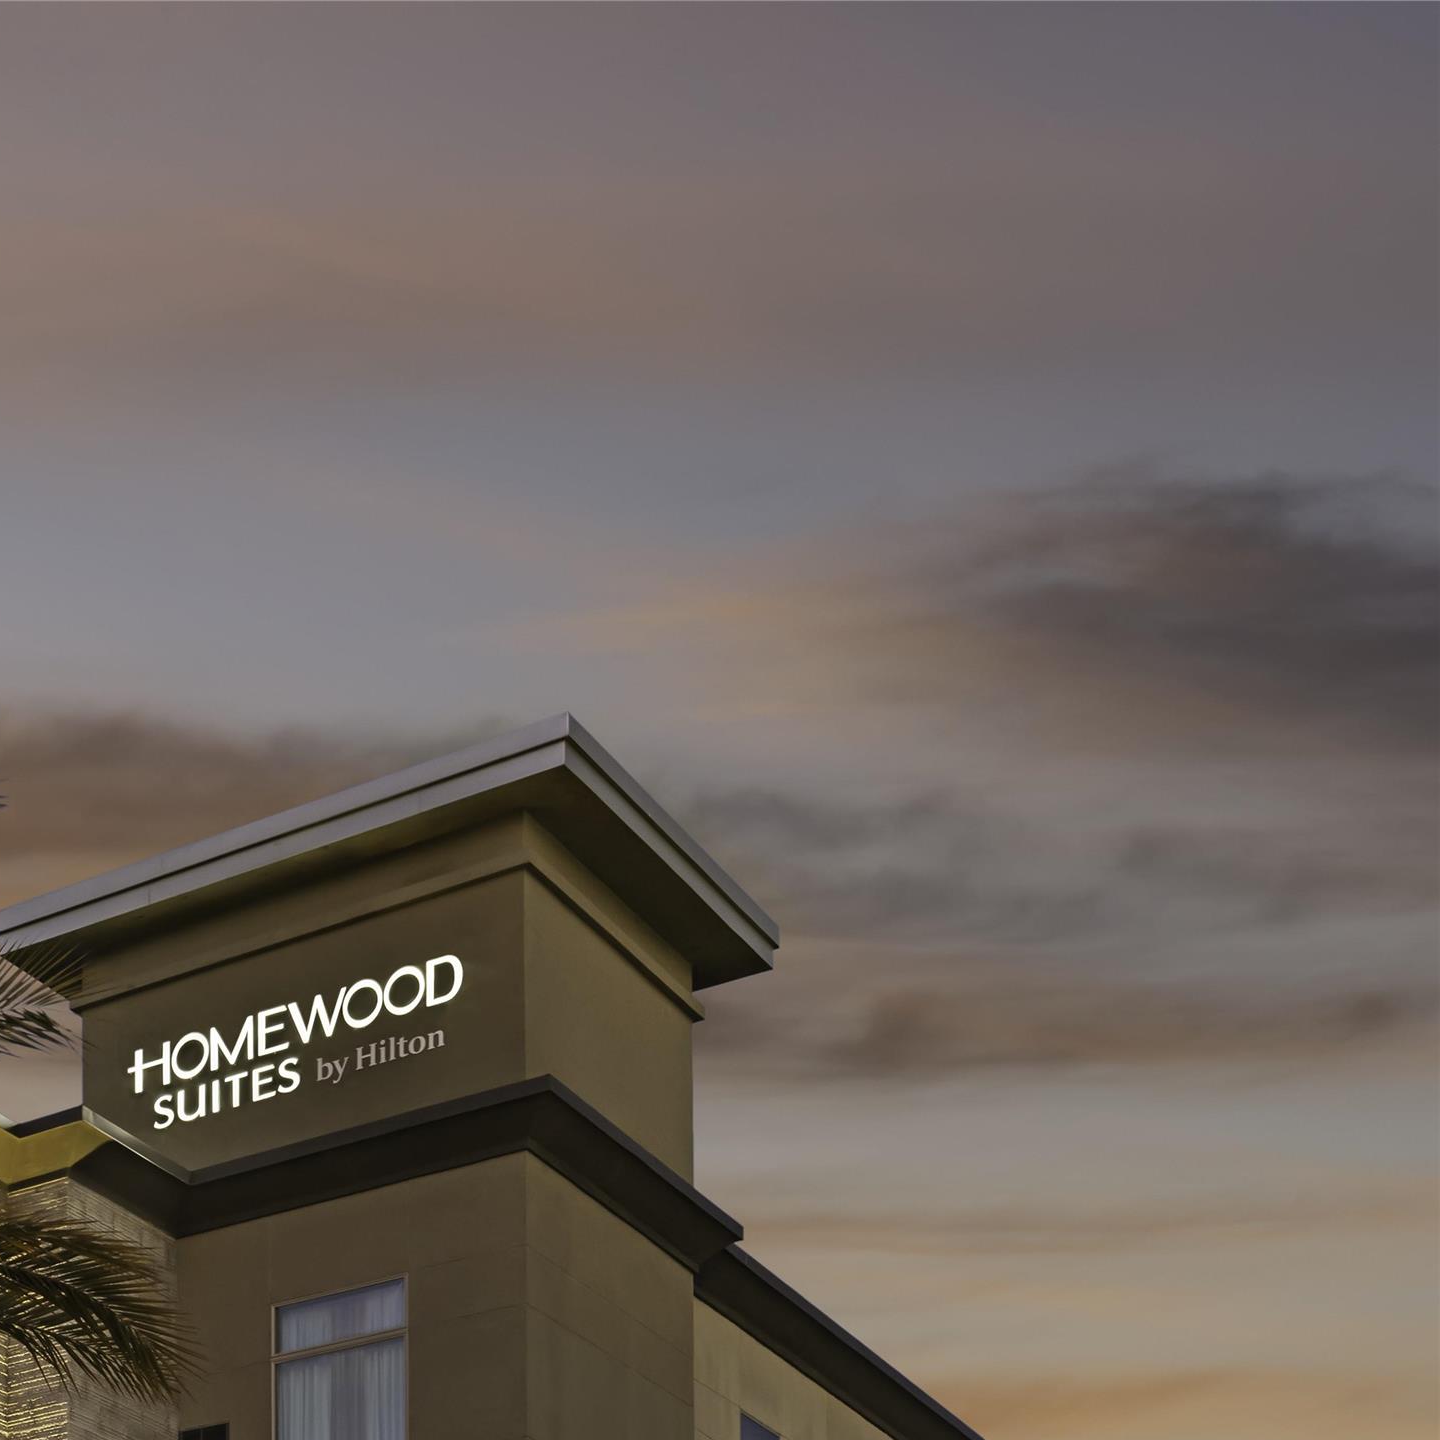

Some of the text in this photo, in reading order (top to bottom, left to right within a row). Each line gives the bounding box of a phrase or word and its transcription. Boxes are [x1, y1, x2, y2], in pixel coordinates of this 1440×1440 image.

[127, 954, 464, 1094] HOMEWOOD
[153, 1029, 445, 1130] SUITES by Hilton
